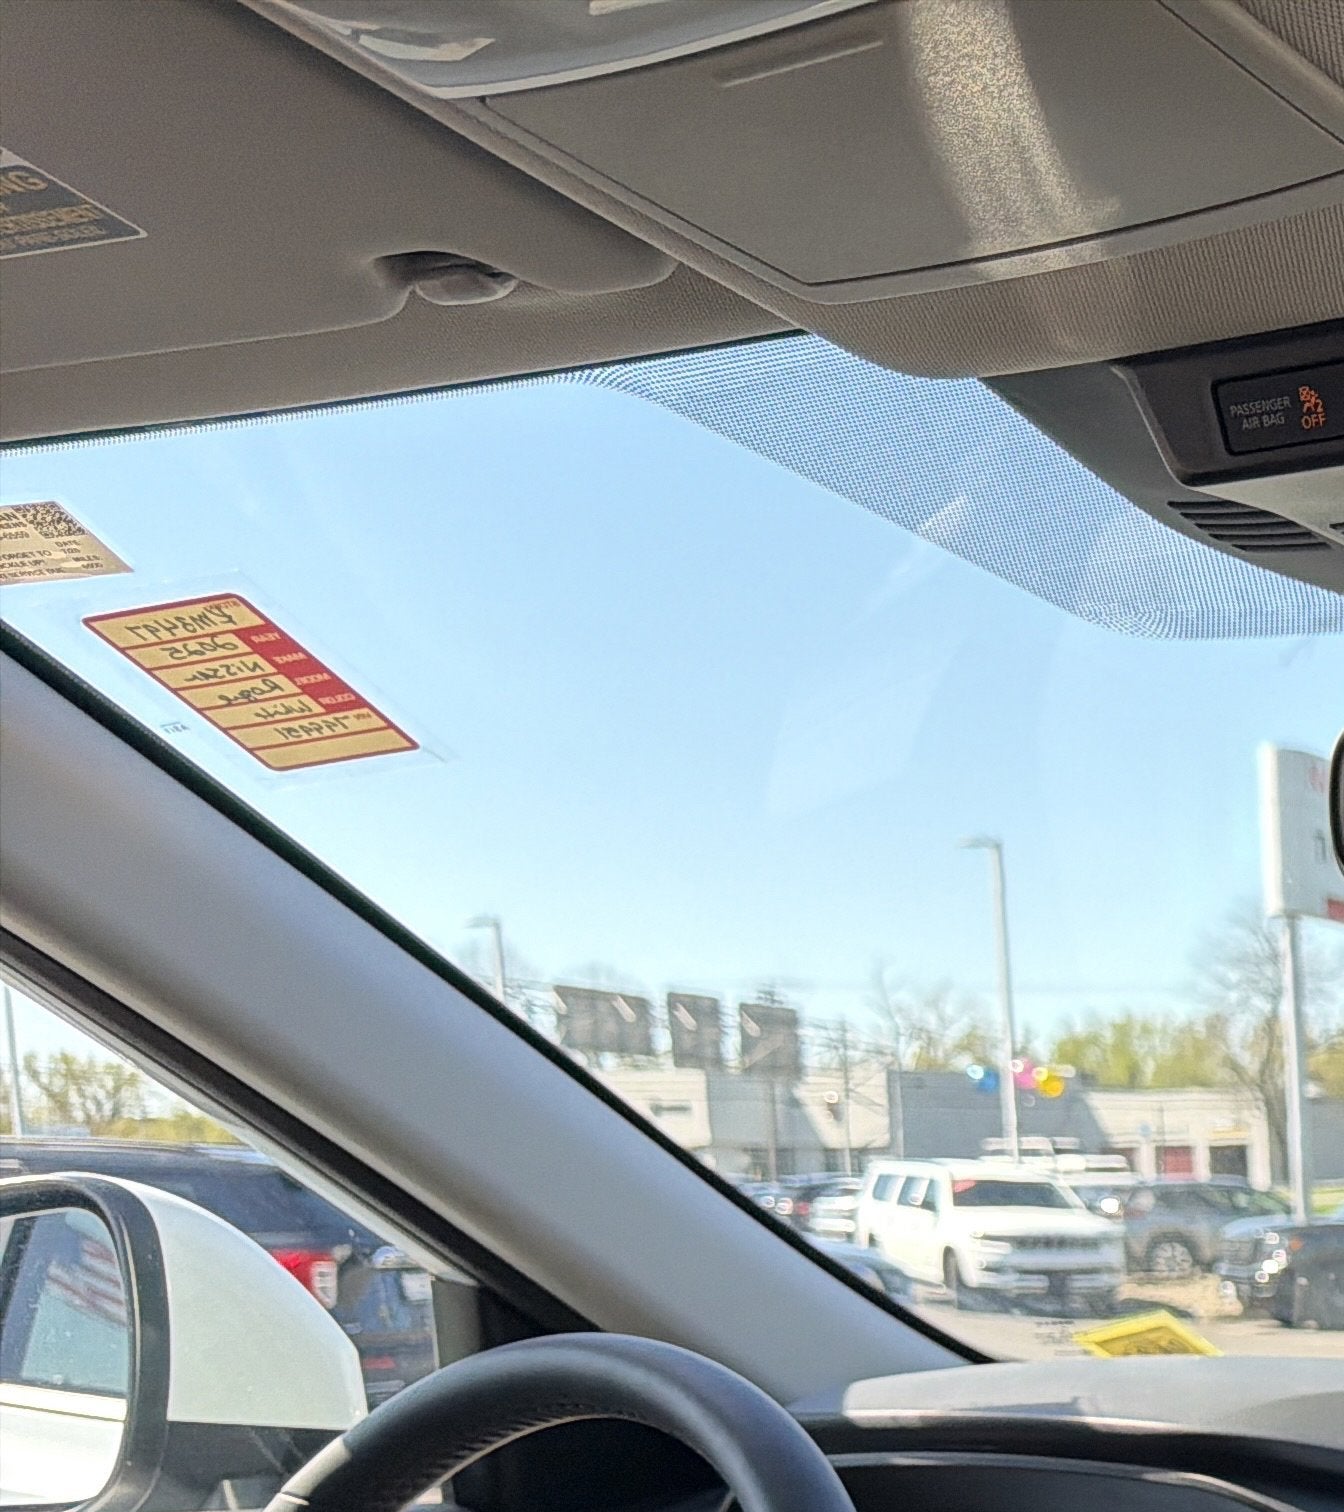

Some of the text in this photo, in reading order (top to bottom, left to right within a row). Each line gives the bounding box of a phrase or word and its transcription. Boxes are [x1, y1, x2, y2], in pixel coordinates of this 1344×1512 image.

[1230, 396, 1292, 417] PASSENGER
[1242, 412, 1285, 431] AIR BAG
[1301, 413, 1326, 429] OFF
